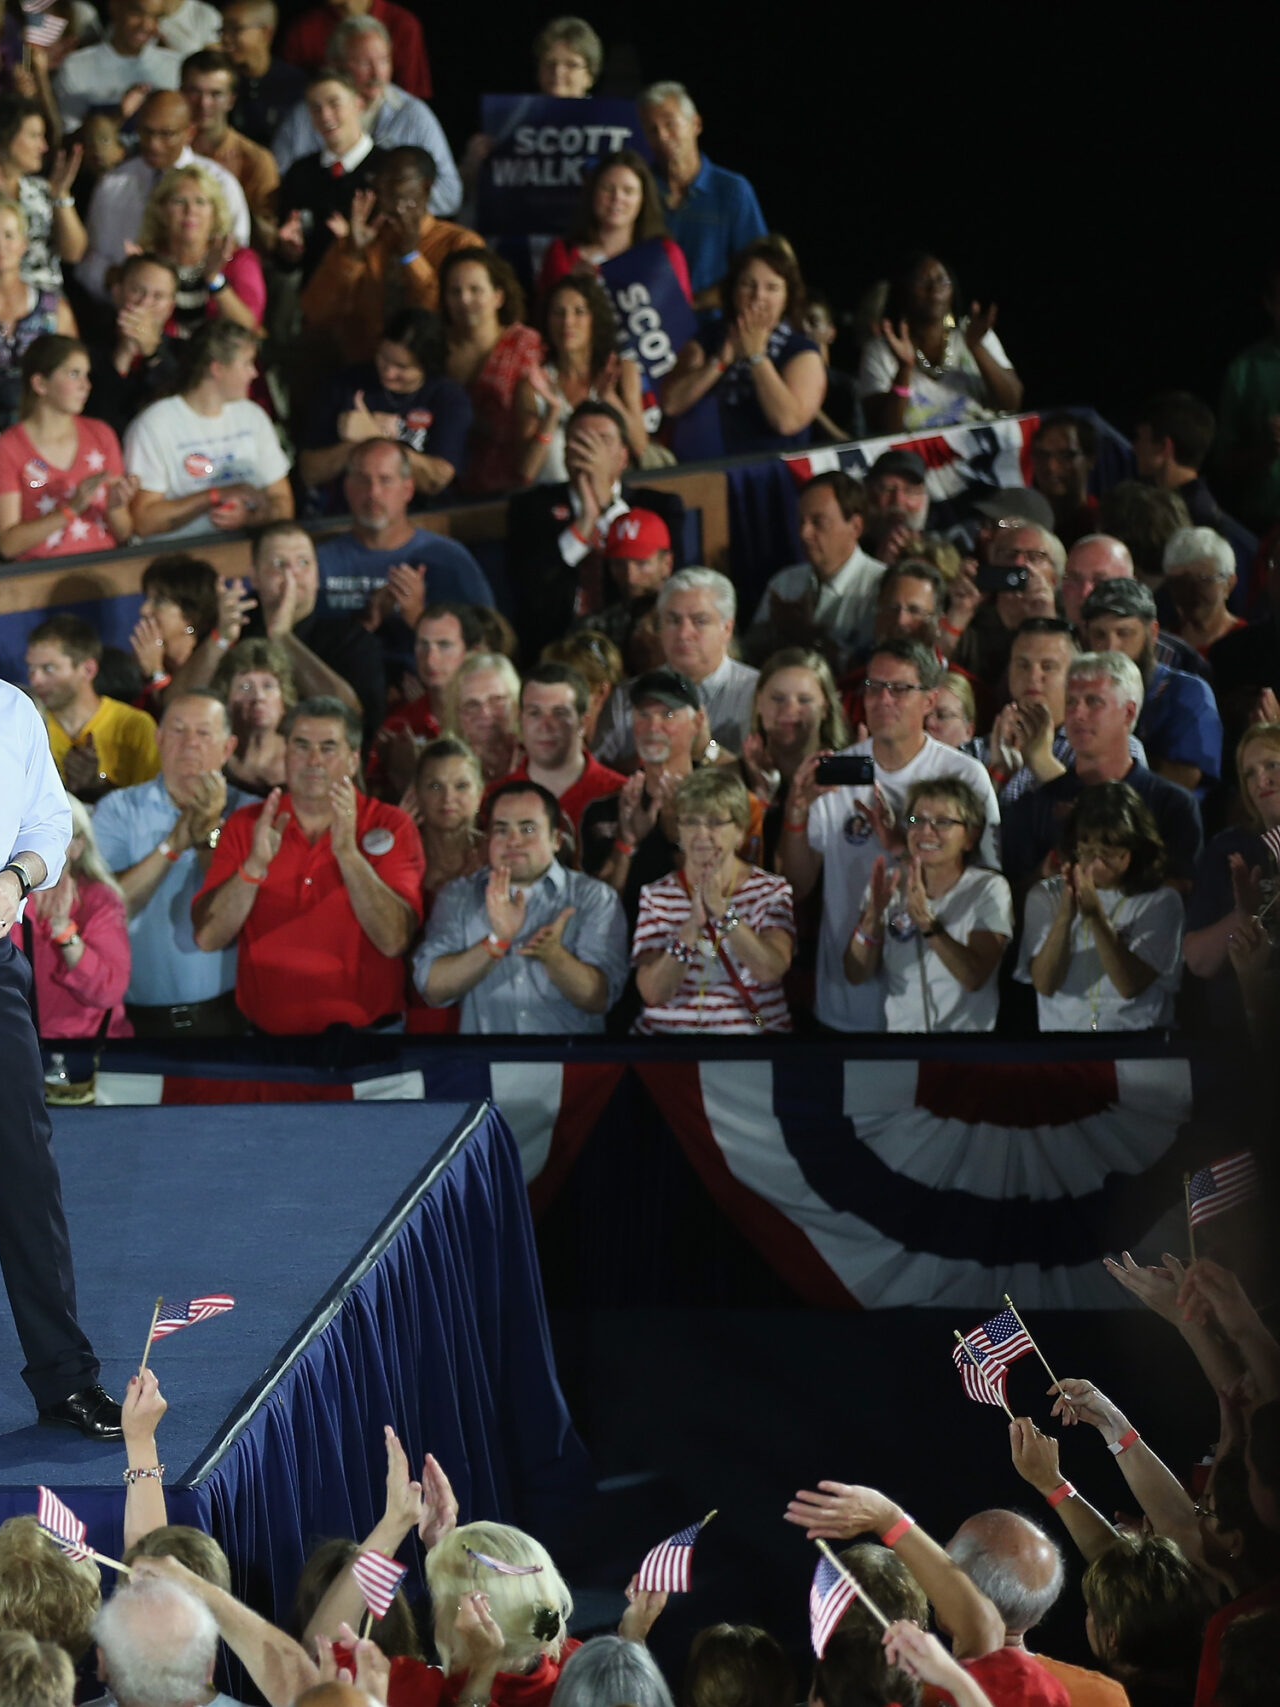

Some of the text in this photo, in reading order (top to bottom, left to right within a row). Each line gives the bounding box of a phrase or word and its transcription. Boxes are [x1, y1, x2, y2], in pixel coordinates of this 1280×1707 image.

[515, 125, 632, 155] SCOTT
[492, 156, 600, 187] WALK
[617, 282, 677, 379] SCOT
